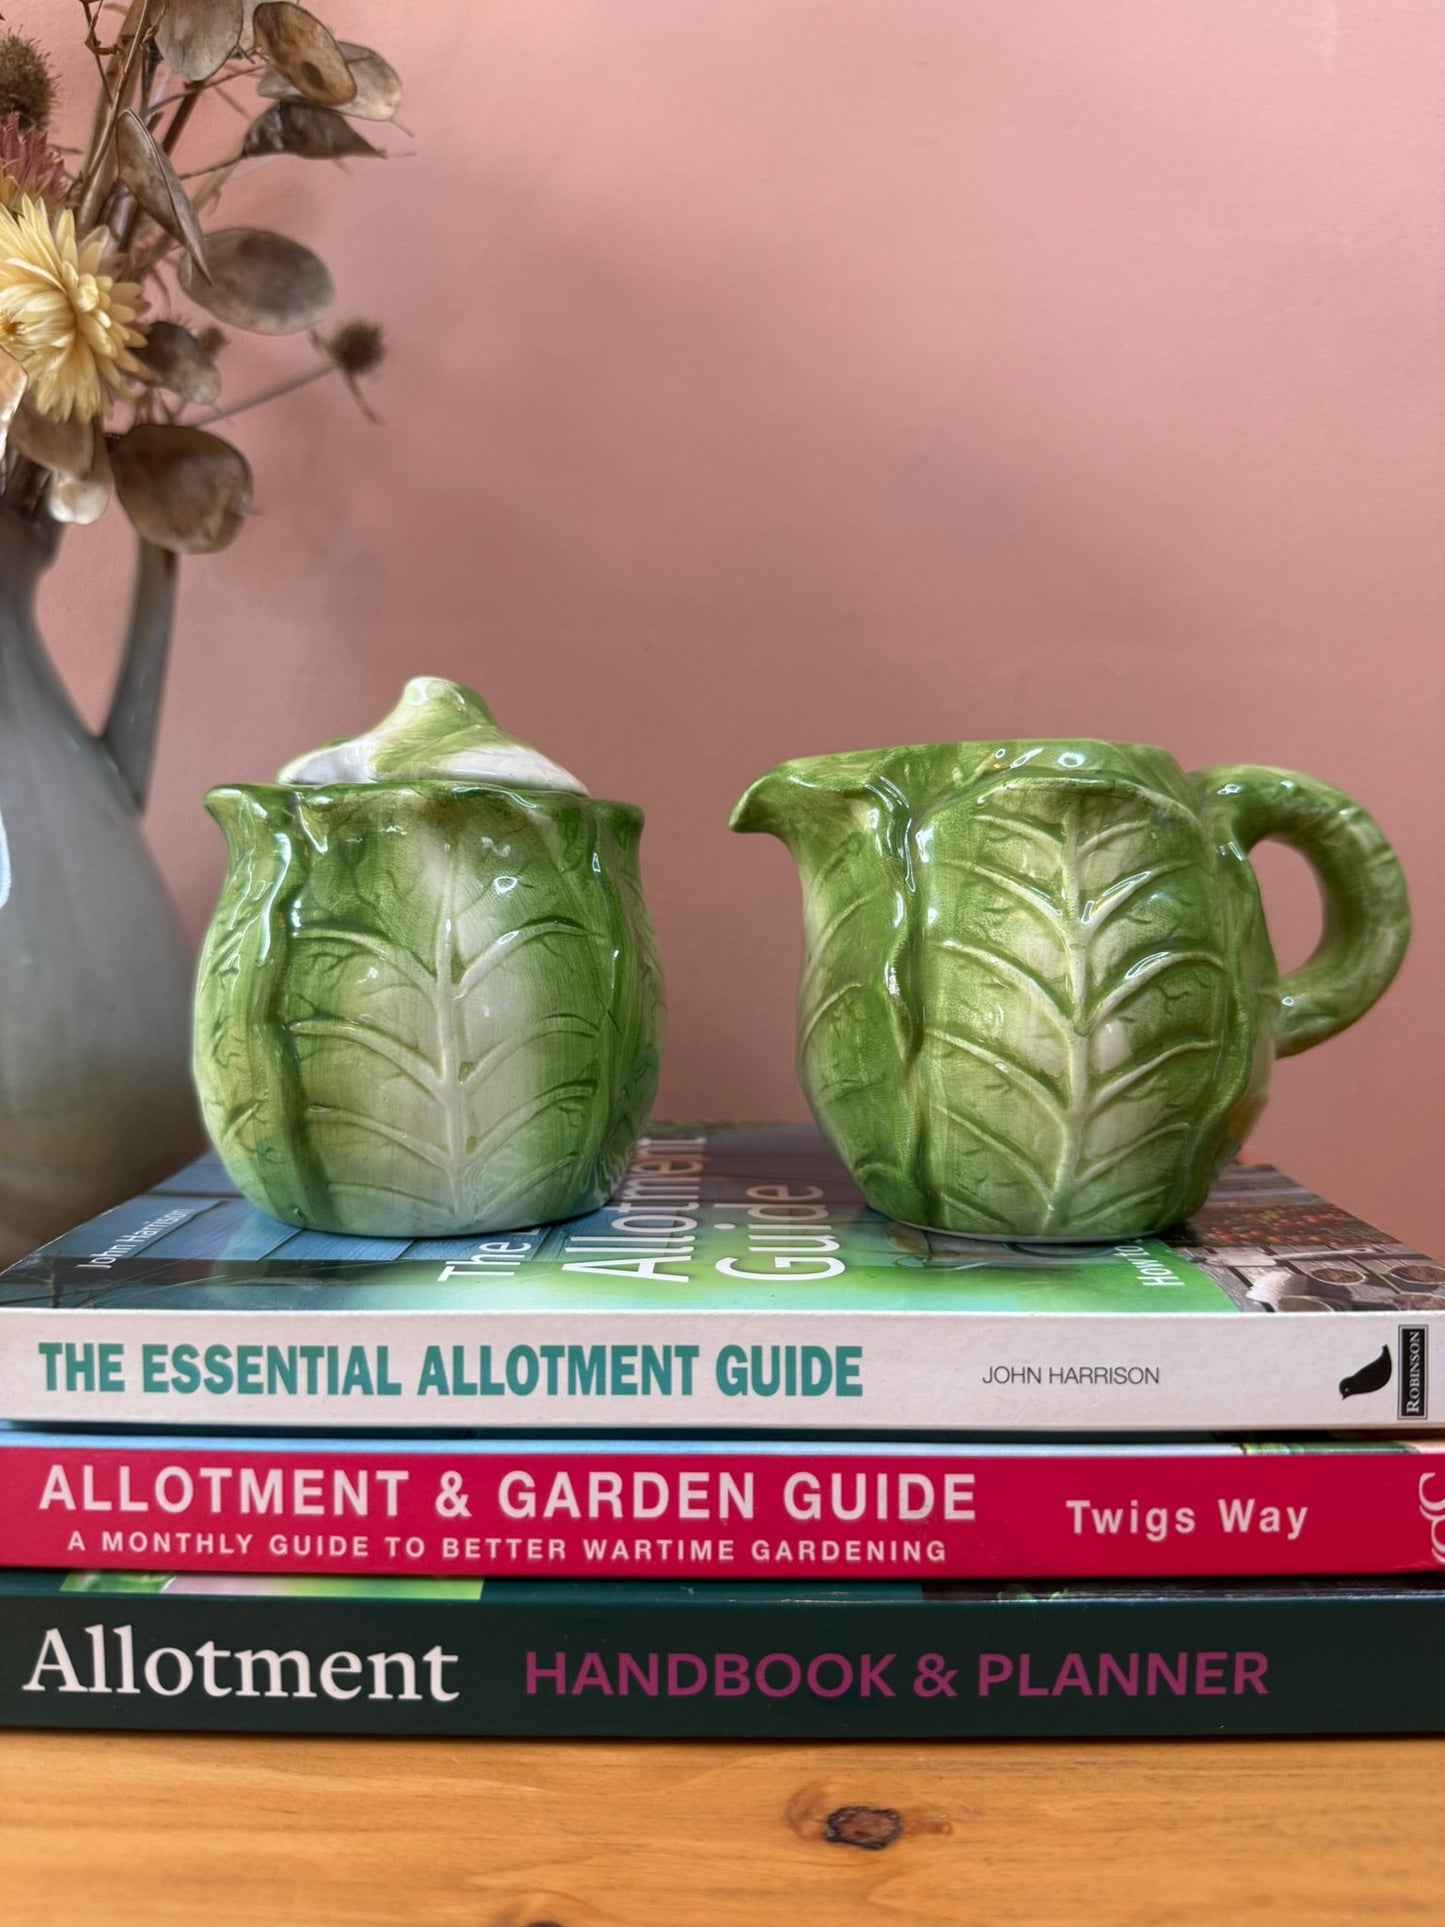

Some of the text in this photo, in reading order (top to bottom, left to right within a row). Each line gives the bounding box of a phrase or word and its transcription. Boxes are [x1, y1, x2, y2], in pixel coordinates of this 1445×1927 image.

[75, 1208, 196, 1269] John Harrison
[714, 1184, 846, 1282] Guide
[437, 1241, 532, 1281] The
[1113, 1245, 1185, 1286] How to
[40, 1344, 863, 1397] THE ESSENTIAL ALLOTMENT GUIDE
[982, 1365, 1160, 1386] JOHN HARRISON
[1405, 1331, 1421, 1414] ROBINSON
[39, 1465, 976, 1522] ALLOTMENT & GARDEN GUIDE
[68, 1530, 946, 1562] A MONTHLY GUIDE TO BETTER WARTIME GARDENING
[1066, 1499, 1308, 1542] Twigs Way
[22, 1624, 460, 1702] Allotment
[526, 1650, 1269, 1700] HANDBOOK & PLANNER
